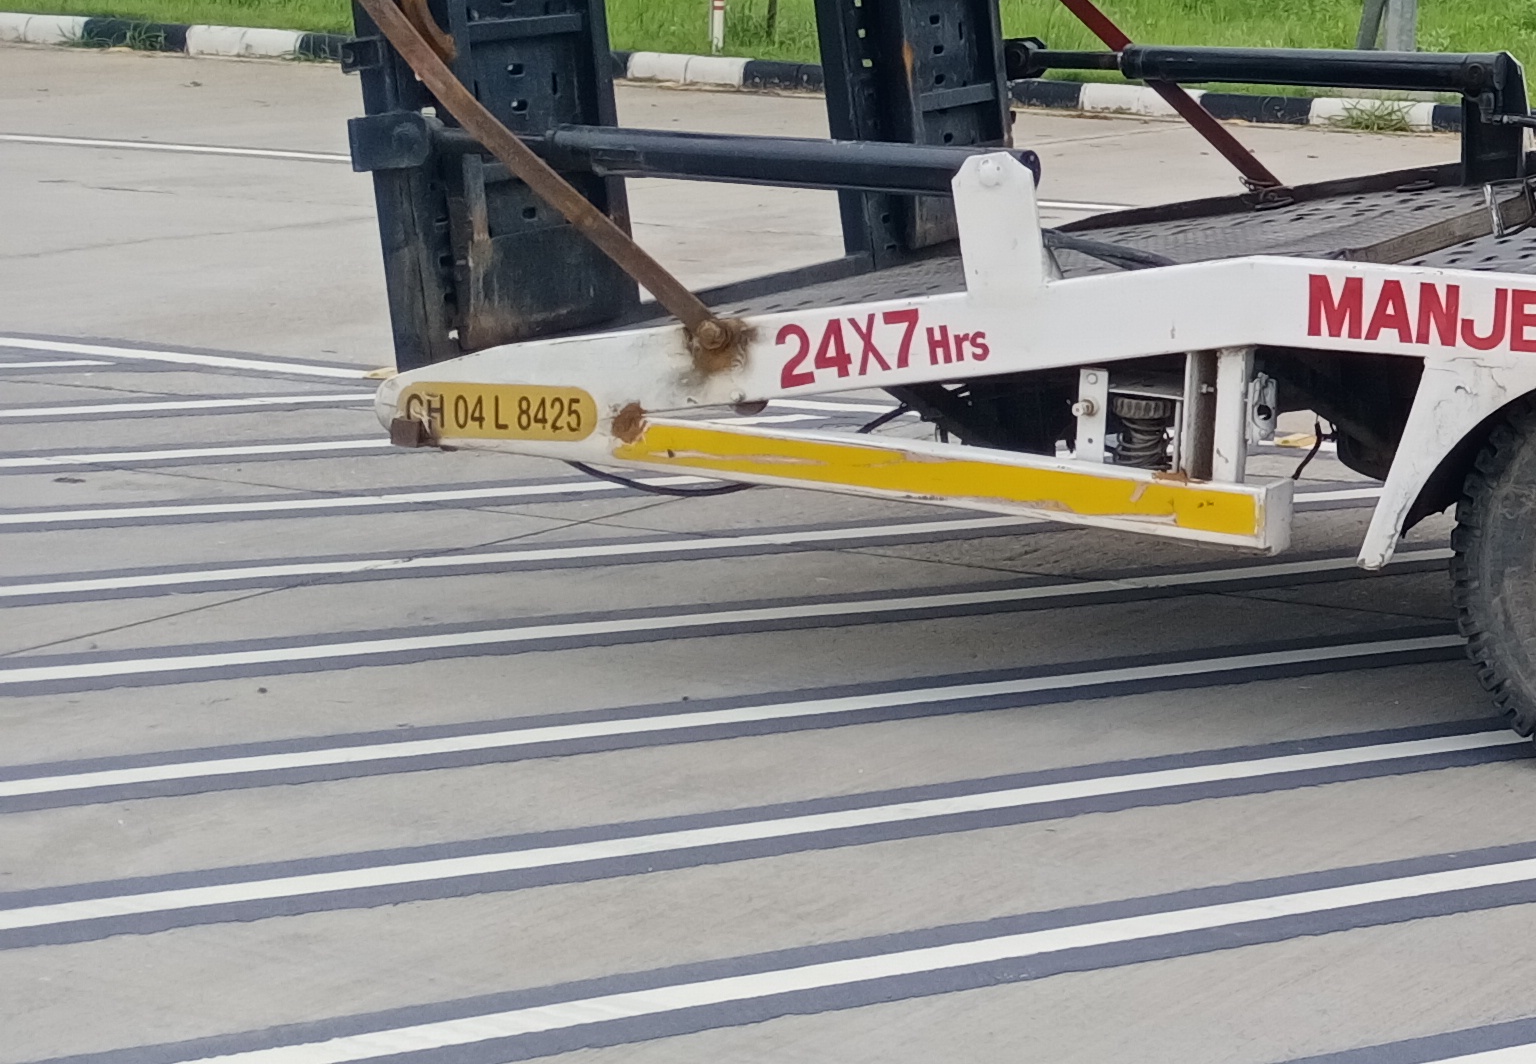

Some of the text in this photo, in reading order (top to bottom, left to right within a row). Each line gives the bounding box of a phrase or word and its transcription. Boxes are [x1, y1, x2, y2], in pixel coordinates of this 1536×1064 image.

[776, 308, 990, 389] 24X7 Hrs
[454, 394, 485, 429] 04
[495, 395, 509, 430] L
[517, 396, 581, 432] 8425
